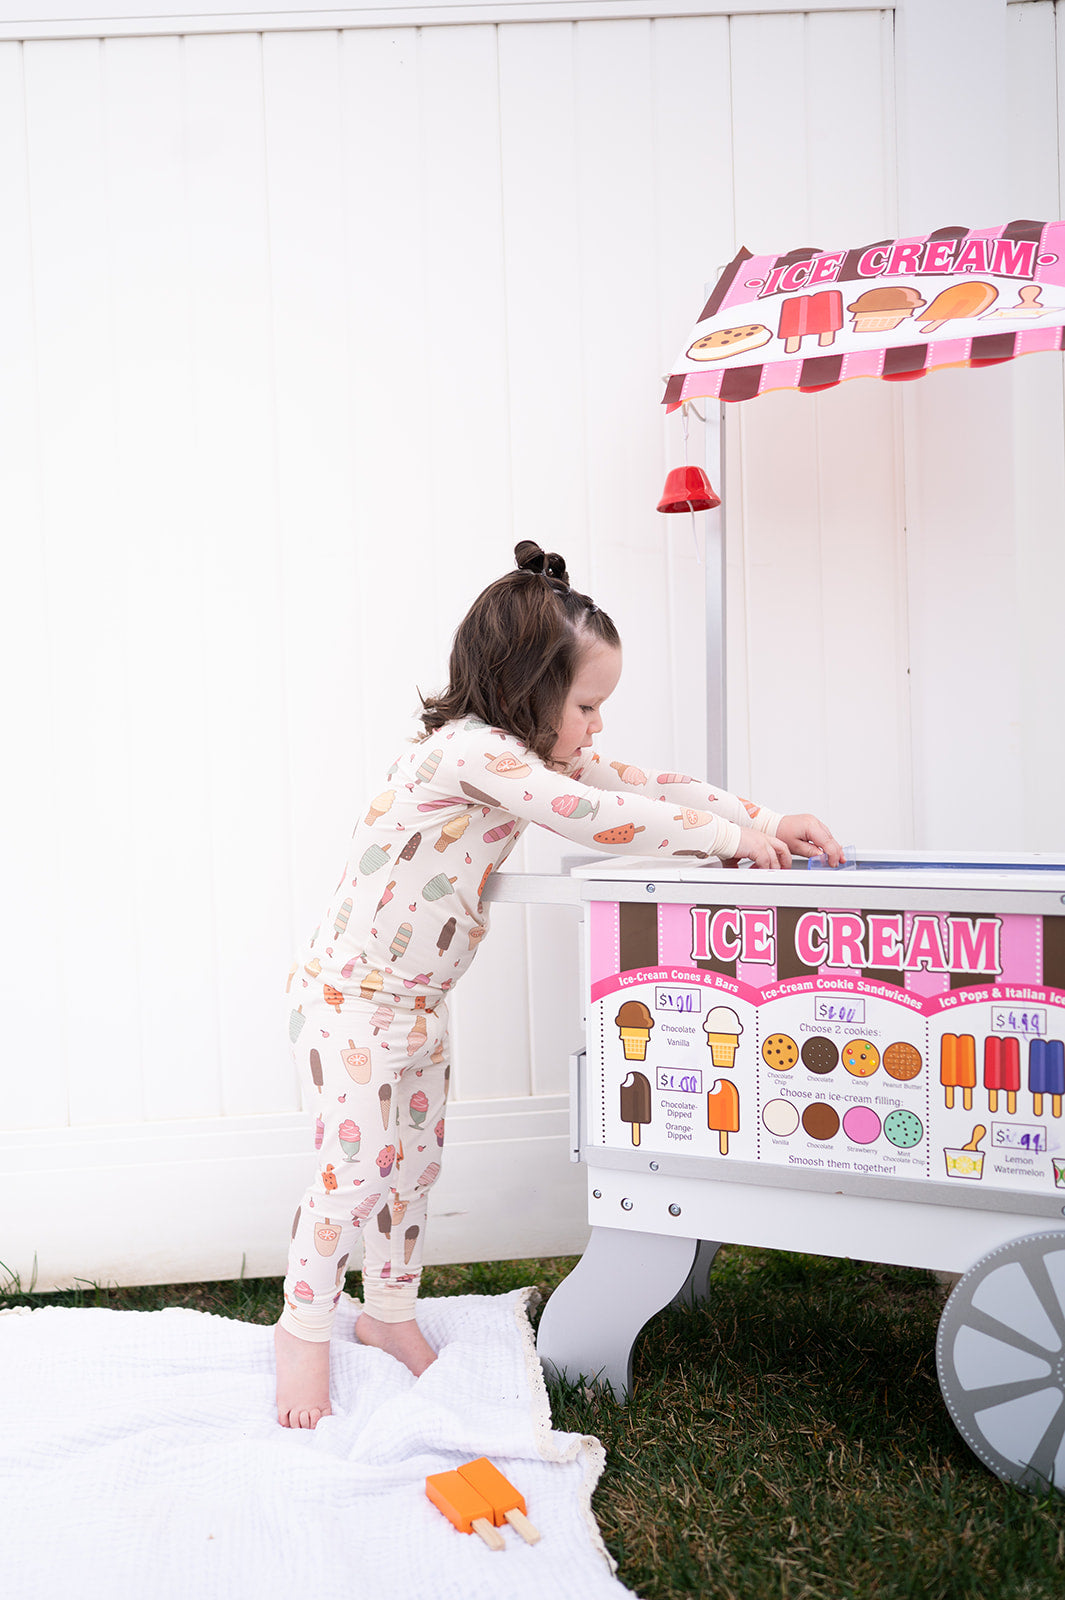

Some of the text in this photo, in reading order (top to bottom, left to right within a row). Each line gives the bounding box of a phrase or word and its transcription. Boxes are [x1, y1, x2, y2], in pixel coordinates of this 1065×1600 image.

[758, 239, 1039, 298] ICE CREAM
[690, 907, 1003, 975] ICE CREAM
[618, 970, 739, 993] Ice-Cream Cones & Bars
[760, 978, 923, 1010] Ice-Cream Cookie Sandwiches
[939, 995, 957, 1007] Ice
[959, 990, 989, 1003] Pops
[991, 987, 1002, 998] &
[1005, 987, 1046, 1001] Italian
[661, 1024, 696, 1034] Chocolate
[799, 1023, 882, 1037] Choose 2 cookies:
[667, 1038, 690, 1047] Vanilla
[767, 1071, 794, 1080] Chocolate
[807, 1075, 834, 1083] Chocolate
[851, 1079, 869, 1088] Candy
[780, 1087, 904, 1108] Choose an ice-cream filling:
[660, 1100, 698, 1110] Chocolate-
[667, 1109, 692, 1119] Dipped
[665, 1122, 694, 1133] Orange-
[667, 1131, 692, 1141] Dipped
[771, 1138, 789, 1146] Vanilla
[806, 1141, 834, 1150] Chocolate
[846, 1145, 878, 1155] Strawberry
[788, 1154, 896, 1174] Smoosh them together!
[882, 1155, 911, 1164] Chocolate
[1004, 1155, 1033, 1165] Lemon
[993, 1165, 1045, 1178] Watermelon
